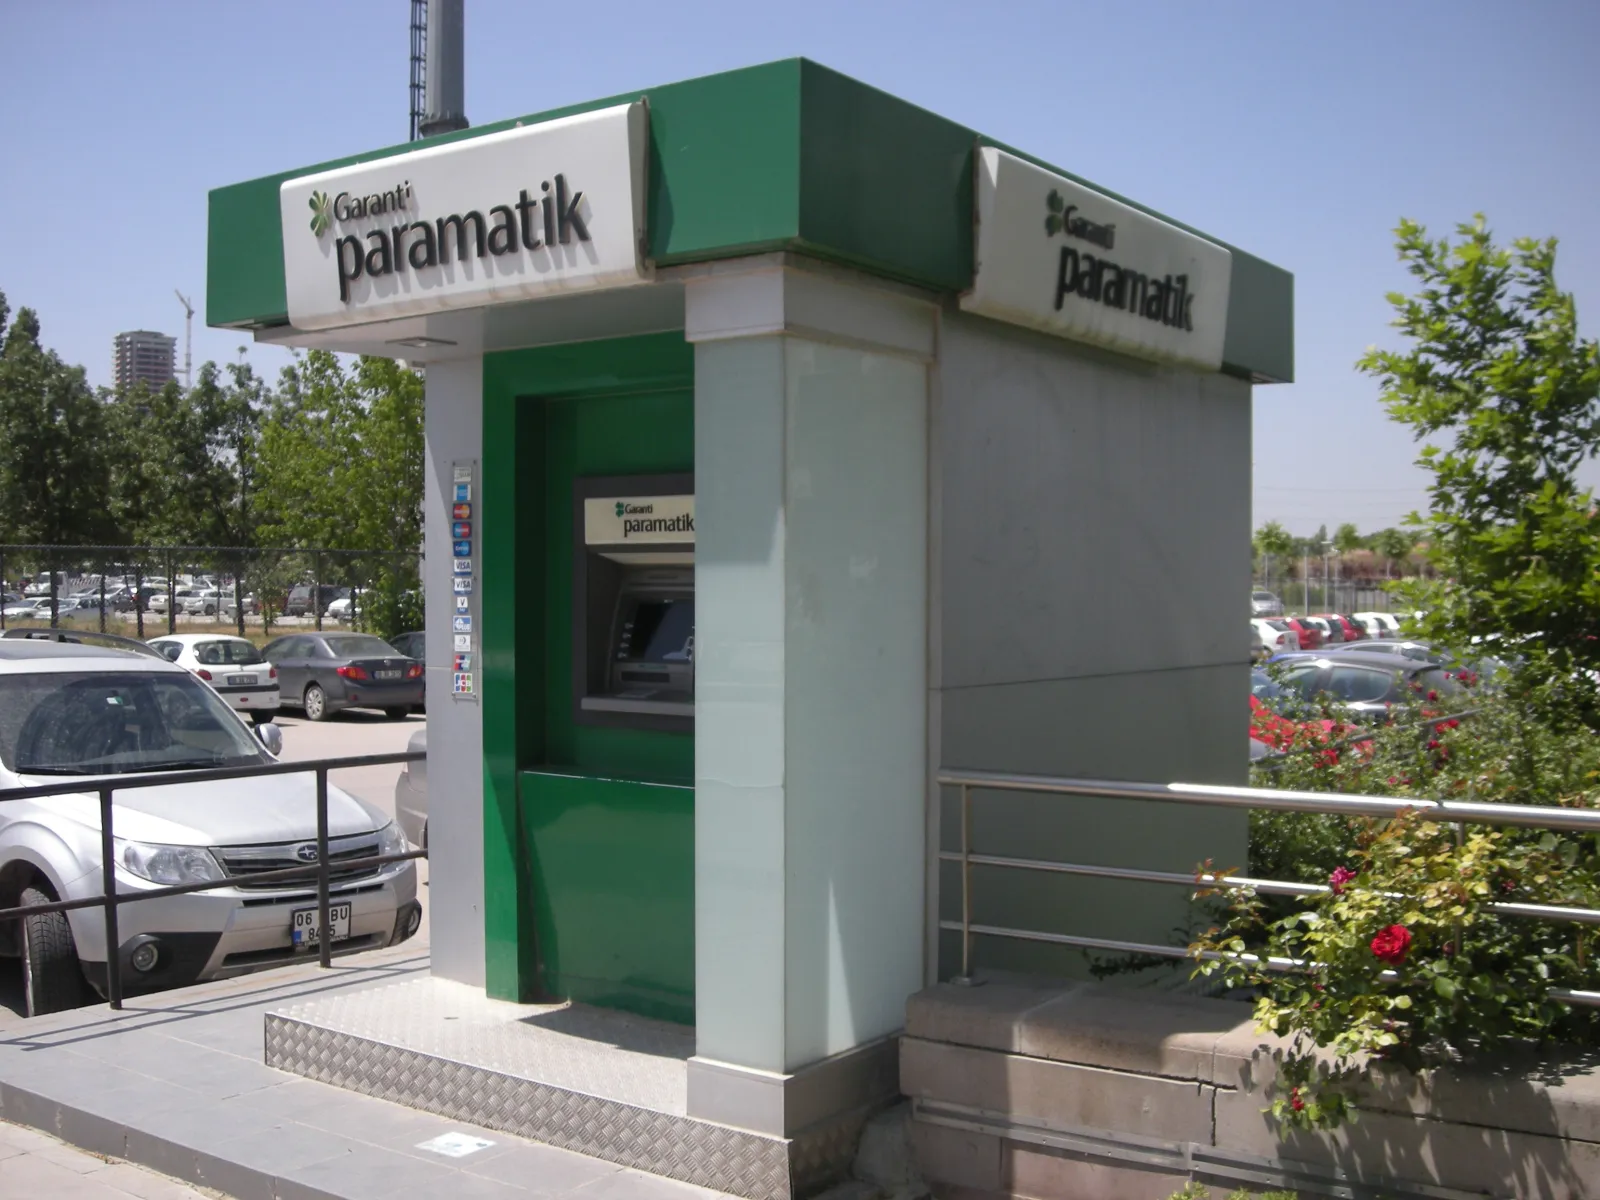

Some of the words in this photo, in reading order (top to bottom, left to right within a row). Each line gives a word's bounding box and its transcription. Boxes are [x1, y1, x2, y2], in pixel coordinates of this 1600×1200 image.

[333, 180, 411, 222] Garanti
[1063, 205, 1116, 249] Garanti
[335, 172, 591, 304] paramatik
[1054, 246, 1194, 331] paramatik
[624, 503, 653, 514] Garanti
[624, 513, 695, 538] paramatik
[456, 561, 471, 570] VISA
[456, 580, 471, 589] VISA
[296, 913, 312, 926] 06
[308, 924, 336, 941] 845
